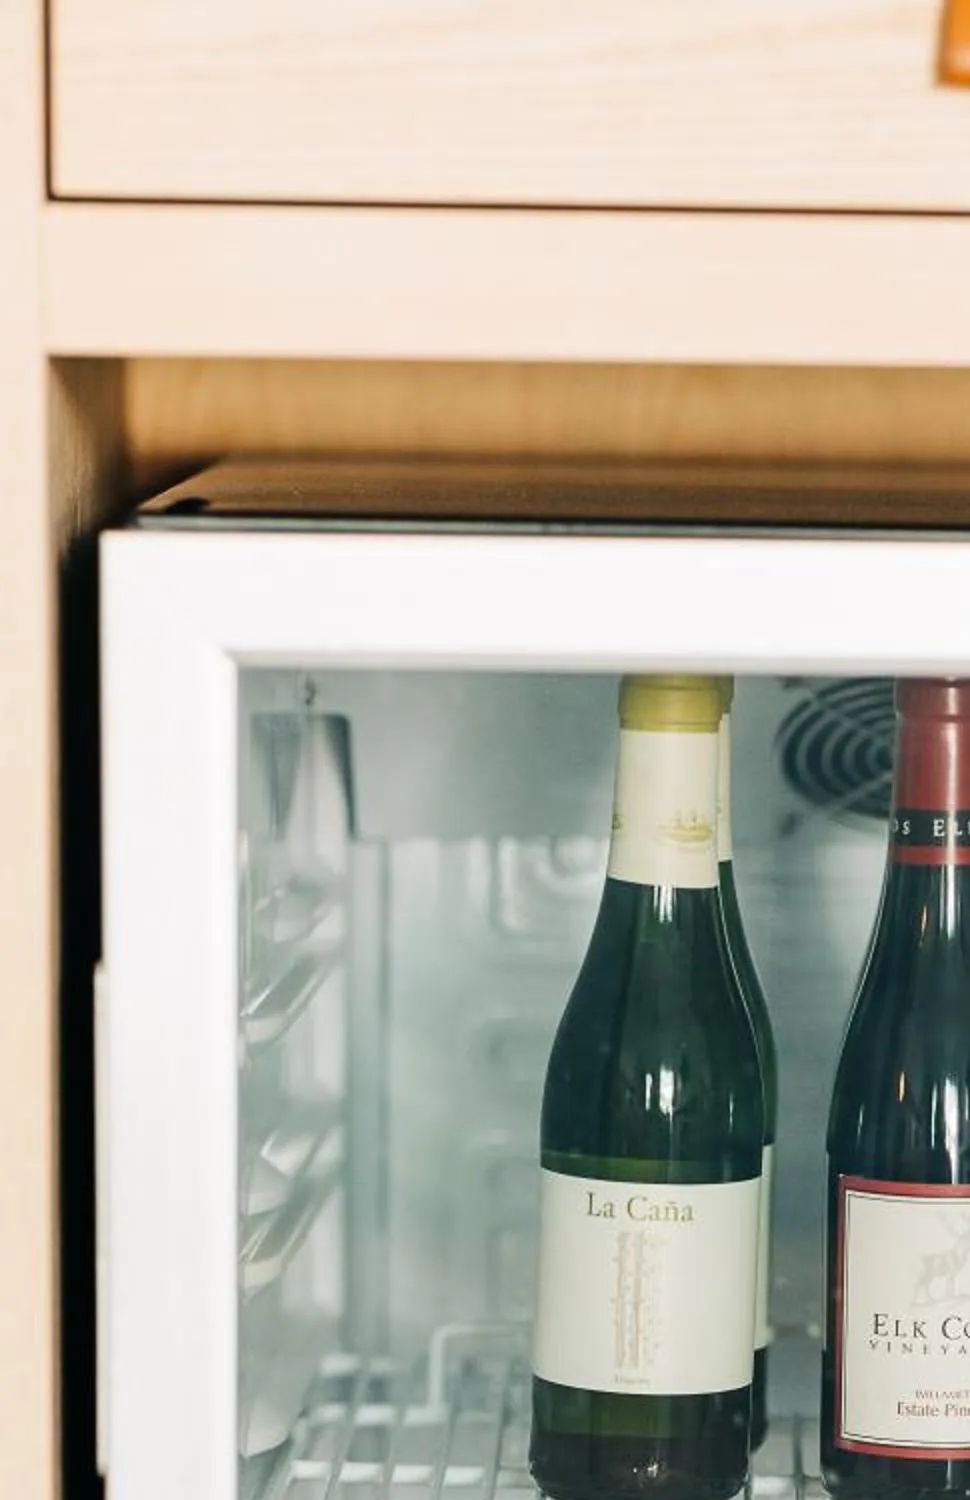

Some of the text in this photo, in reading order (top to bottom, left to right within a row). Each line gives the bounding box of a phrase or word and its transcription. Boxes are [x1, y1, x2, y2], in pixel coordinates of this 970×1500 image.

[586, 1191, 695, 1222] La Caña
[873, 1313, 927, 1339] ELK
[897, 1401, 940, 1417] Estate
